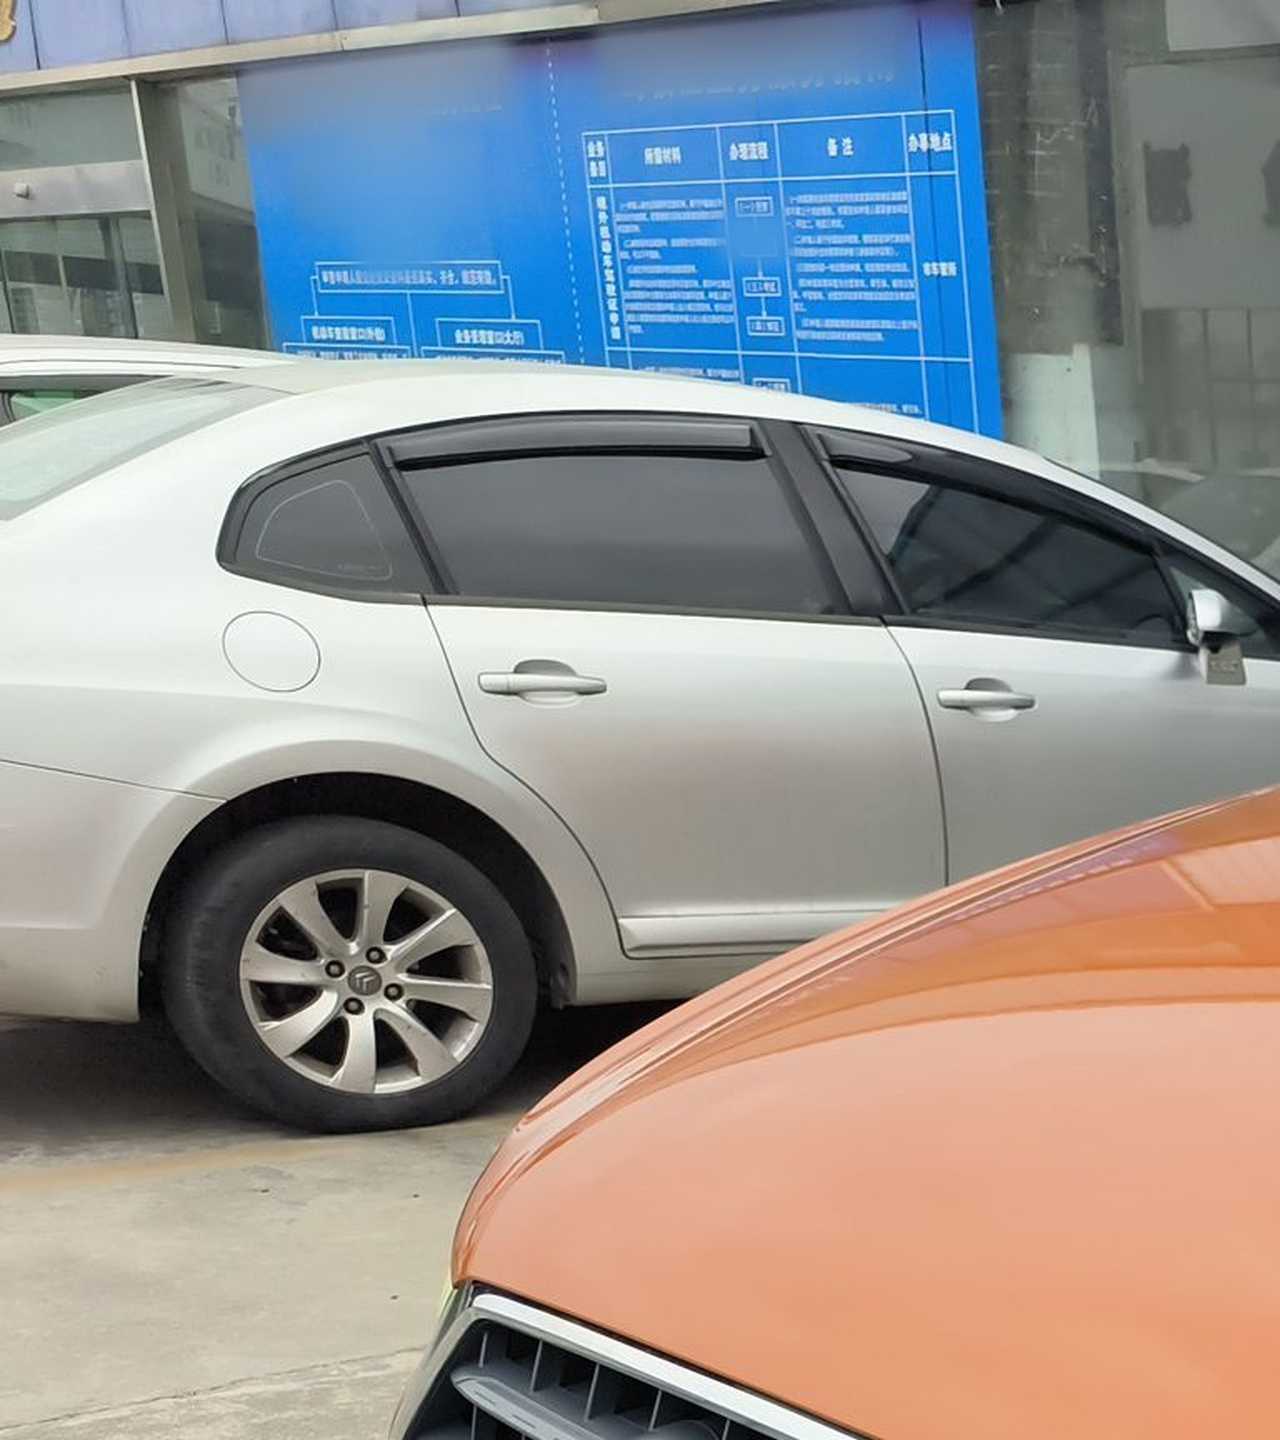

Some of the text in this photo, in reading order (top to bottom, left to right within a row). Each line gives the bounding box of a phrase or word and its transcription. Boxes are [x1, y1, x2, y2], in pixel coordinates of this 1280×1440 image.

[729, 141, 769, 161] 办理流程
[908, 131, 953, 153] 办事地点
[644, 146, 681, 165] 所需材料
